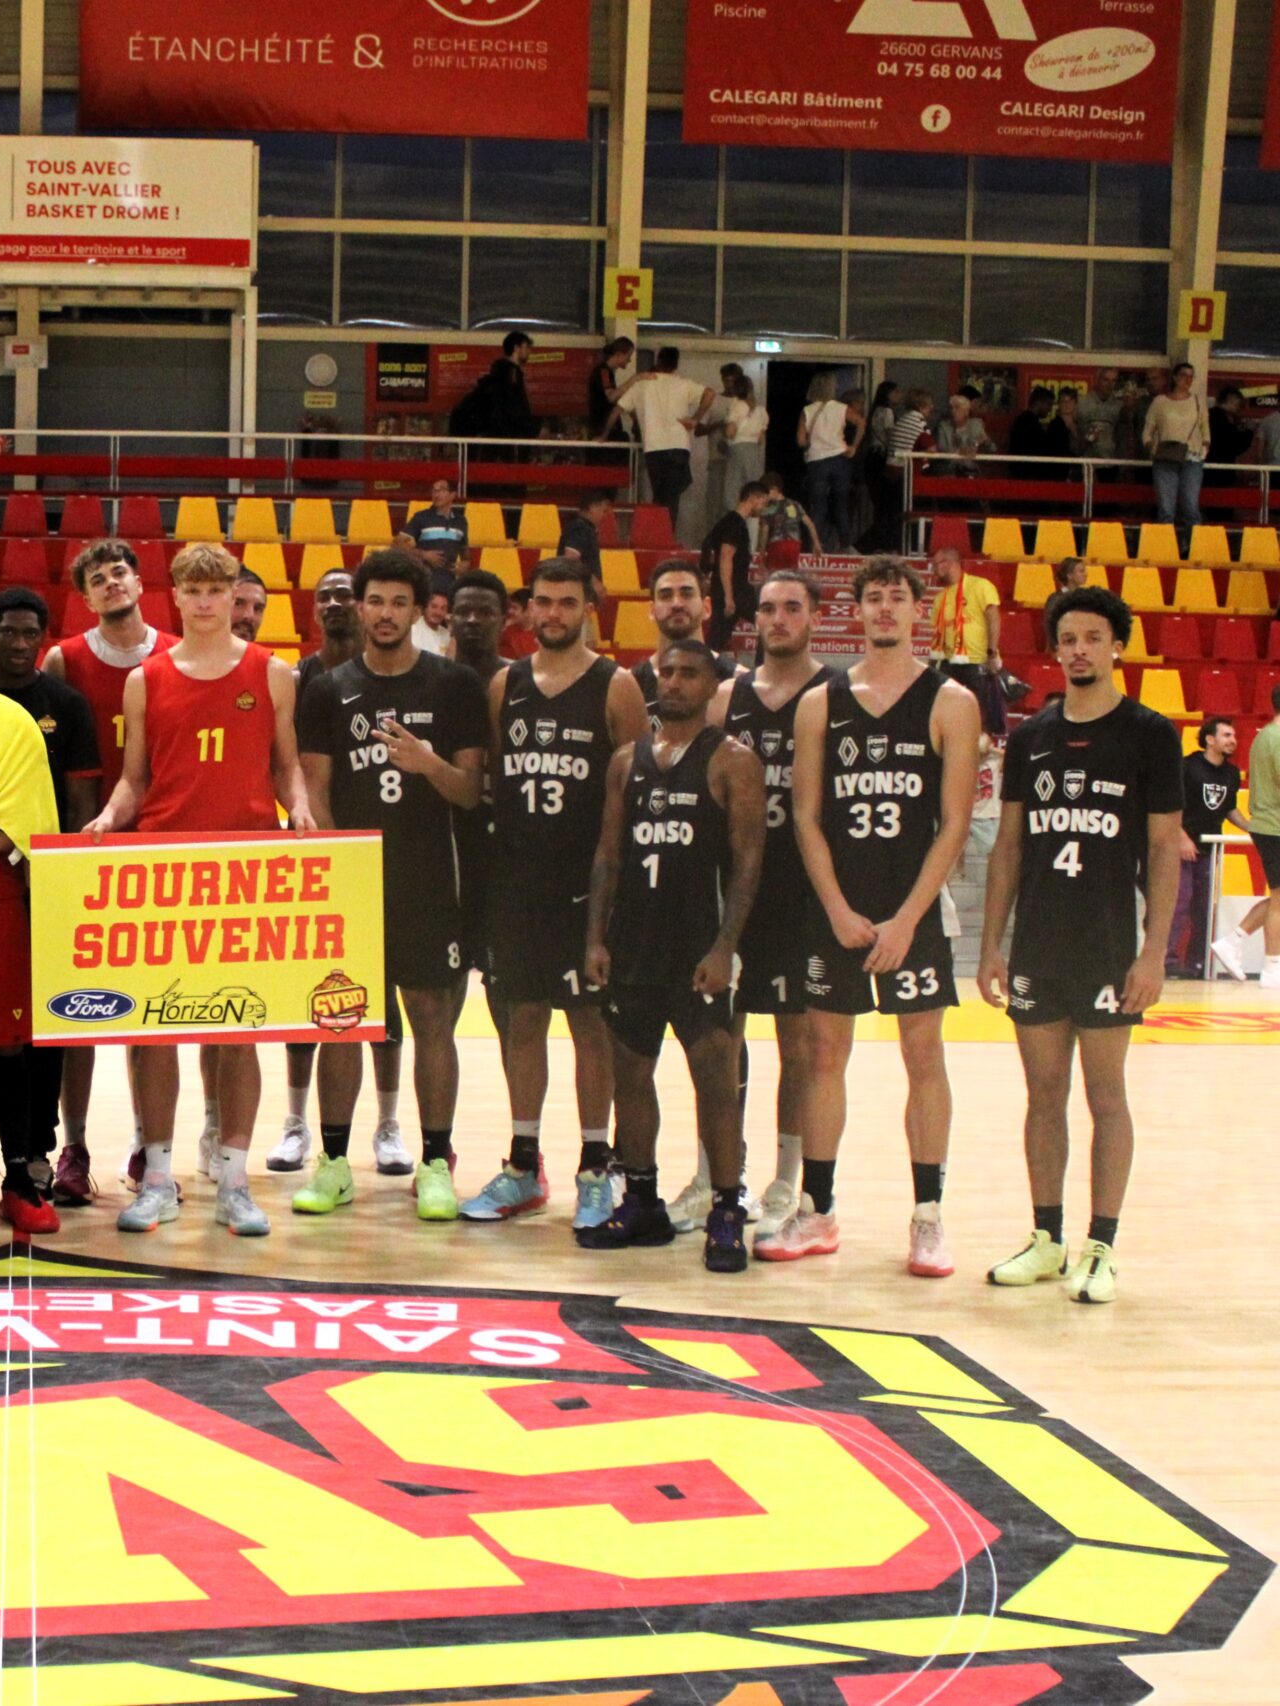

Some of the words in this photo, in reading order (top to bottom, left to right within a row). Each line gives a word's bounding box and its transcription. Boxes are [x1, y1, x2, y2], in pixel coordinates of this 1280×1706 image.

[714, 4, 767, 18] Piscine
[1100, 0, 1155, 14] Terrasse
[128, 31, 335, 64] ÉTANCHÉITÉ
[354, 33, 385, 69] &
[413, 38, 549, 53] RECHERCHES
[879, 42, 926, 57] 26600
[931, 45, 1003, 60] GERVANS
[412, 56, 548, 71] D'INFILTRATIONS
[877, 62, 898, 76] 04
[904, 63, 924, 77] 75
[930, 65, 950, 78] 68
[956, 66, 976, 79] 00
[981, 67, 1002, 80] 44
[709, 89, 798, 106] CALEGARI
[803, 91, 883, 109] Bâtiment
[1000, 101, 1084, 118] CALEGARI
[1089, 106, 1145, 124] Design
[710, 113, 879, 130] contact@calegaribatiment.fr
[997, 125, 1144, 141] contact@calegaridesign.fr
[26, 160, 77, 175] TOUS
[81, 161, 131, 176] AVEC
[26, 182, 162, 198] SAINT-VALLIER
[26, 204, 97, 219] BASKET
[102, 202, 169, 220] DRÔME
[29, 244, 56, 257] pour
[59, 243, 70, 255] le
[73, 243, 124, 256] territoire
[127, 245, 139, 256] et
[141, 245, 152, 256] le
[155, 245, 187, 259] sport
[615, 275, 640, 311] E
[1189, 297, 1214, 332] D
[196, 727, 225, 762] 11
[503, 752, 590, 781] LYONSO
[379, 769, 403, 803] 8
[520, 779, 565, 815] 13
[834, 770, 924, 799] LYONSO
[847, 801, 901, 839] 33
[1028, 807, 1120, 838] LYONSO
[641, 853, 660, 889] 1
[1052, 840, 1083, 877] 4
[83, 854, 332, 911] JOURNÉE
[72, 914, 345, 969] SOUVENIR
[447, 941, 461, 969] 8
[895, 967, 940, 1001] 33
[64, 993, 119, 1016] Ford
[313, 989, 365, 1017] SVBD
[1094, 984, 1120, 1014] 4
